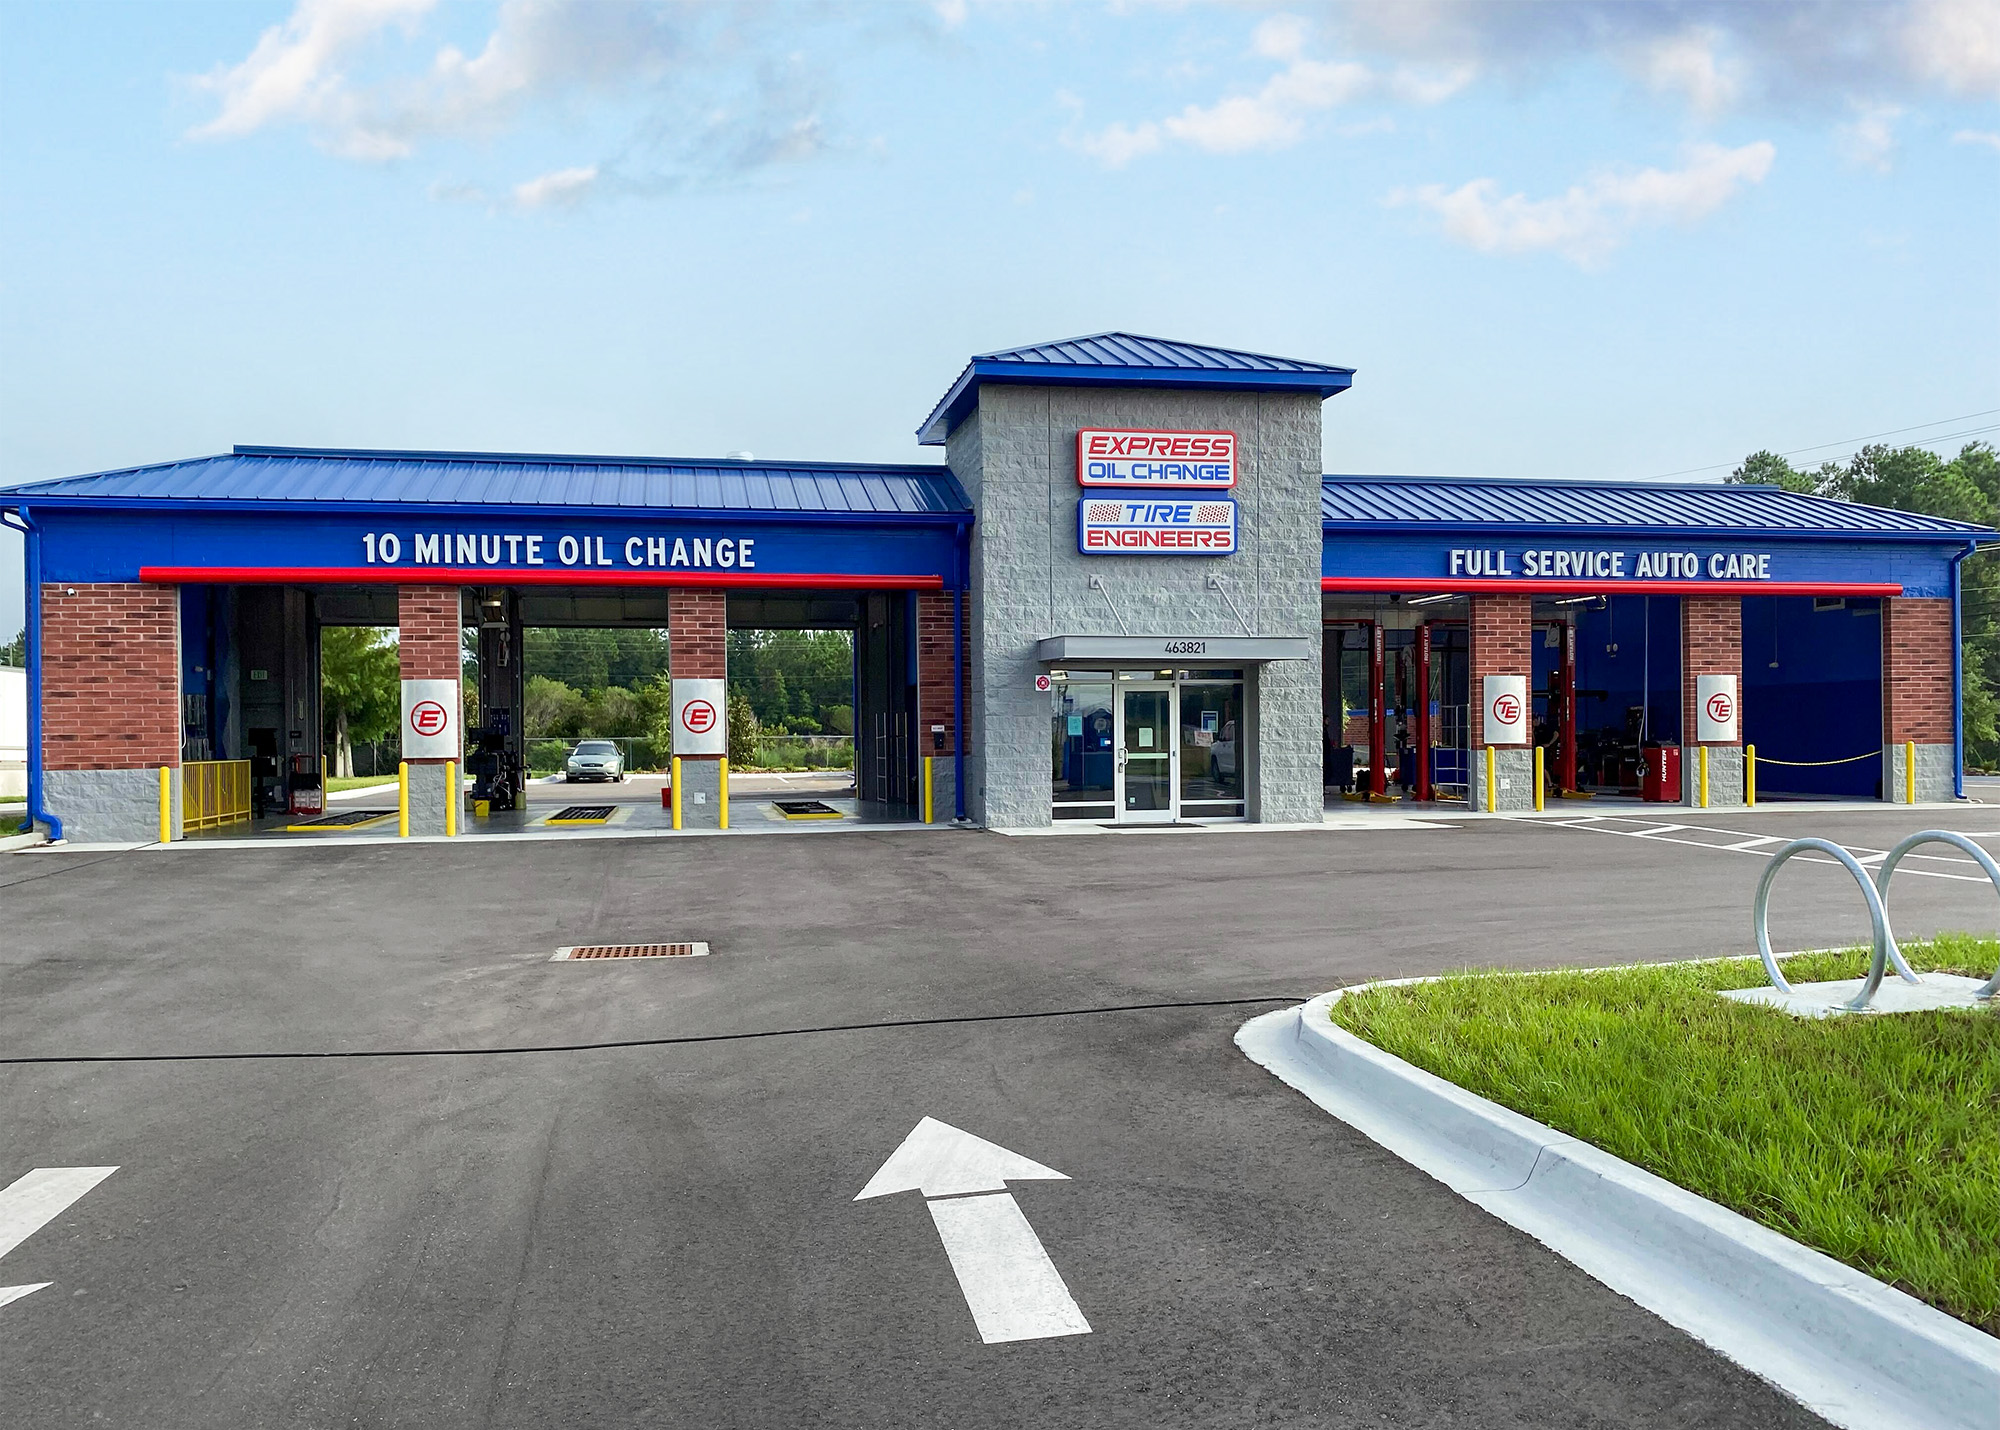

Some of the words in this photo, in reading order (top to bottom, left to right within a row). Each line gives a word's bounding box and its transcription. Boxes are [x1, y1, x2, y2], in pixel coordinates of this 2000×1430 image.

[1088, 436, 1231, 457] EXPRESS
[1088, 462, 1126, 479] OIL
[1131, 463, 1230, 481] CHANGE
[1126, 504, 1193, 523] TIRE
[1087, 530, 1231, 547] ENGINEERS
[363, 533, 401, 564] 10
[415, 533, 544, 565] MINUTE
[558, 535, 613, 566] OIL
[625, 536, 755, 568] CHANGE
[1450, 549, 1512, 576] FULL
[1522, 550, 1625, 577] SERVICE
[1635, 552, 1699, 578] AUTO
[1708, 553, 1771, 579] CARE
[1164, 641, 1206, 654] 463821
[689, 709, 711, 725] E
[1498, 701, 1519, 719] TE
[1711, 700, 1731, 717] TE
[418, 710, 441, 727] E
